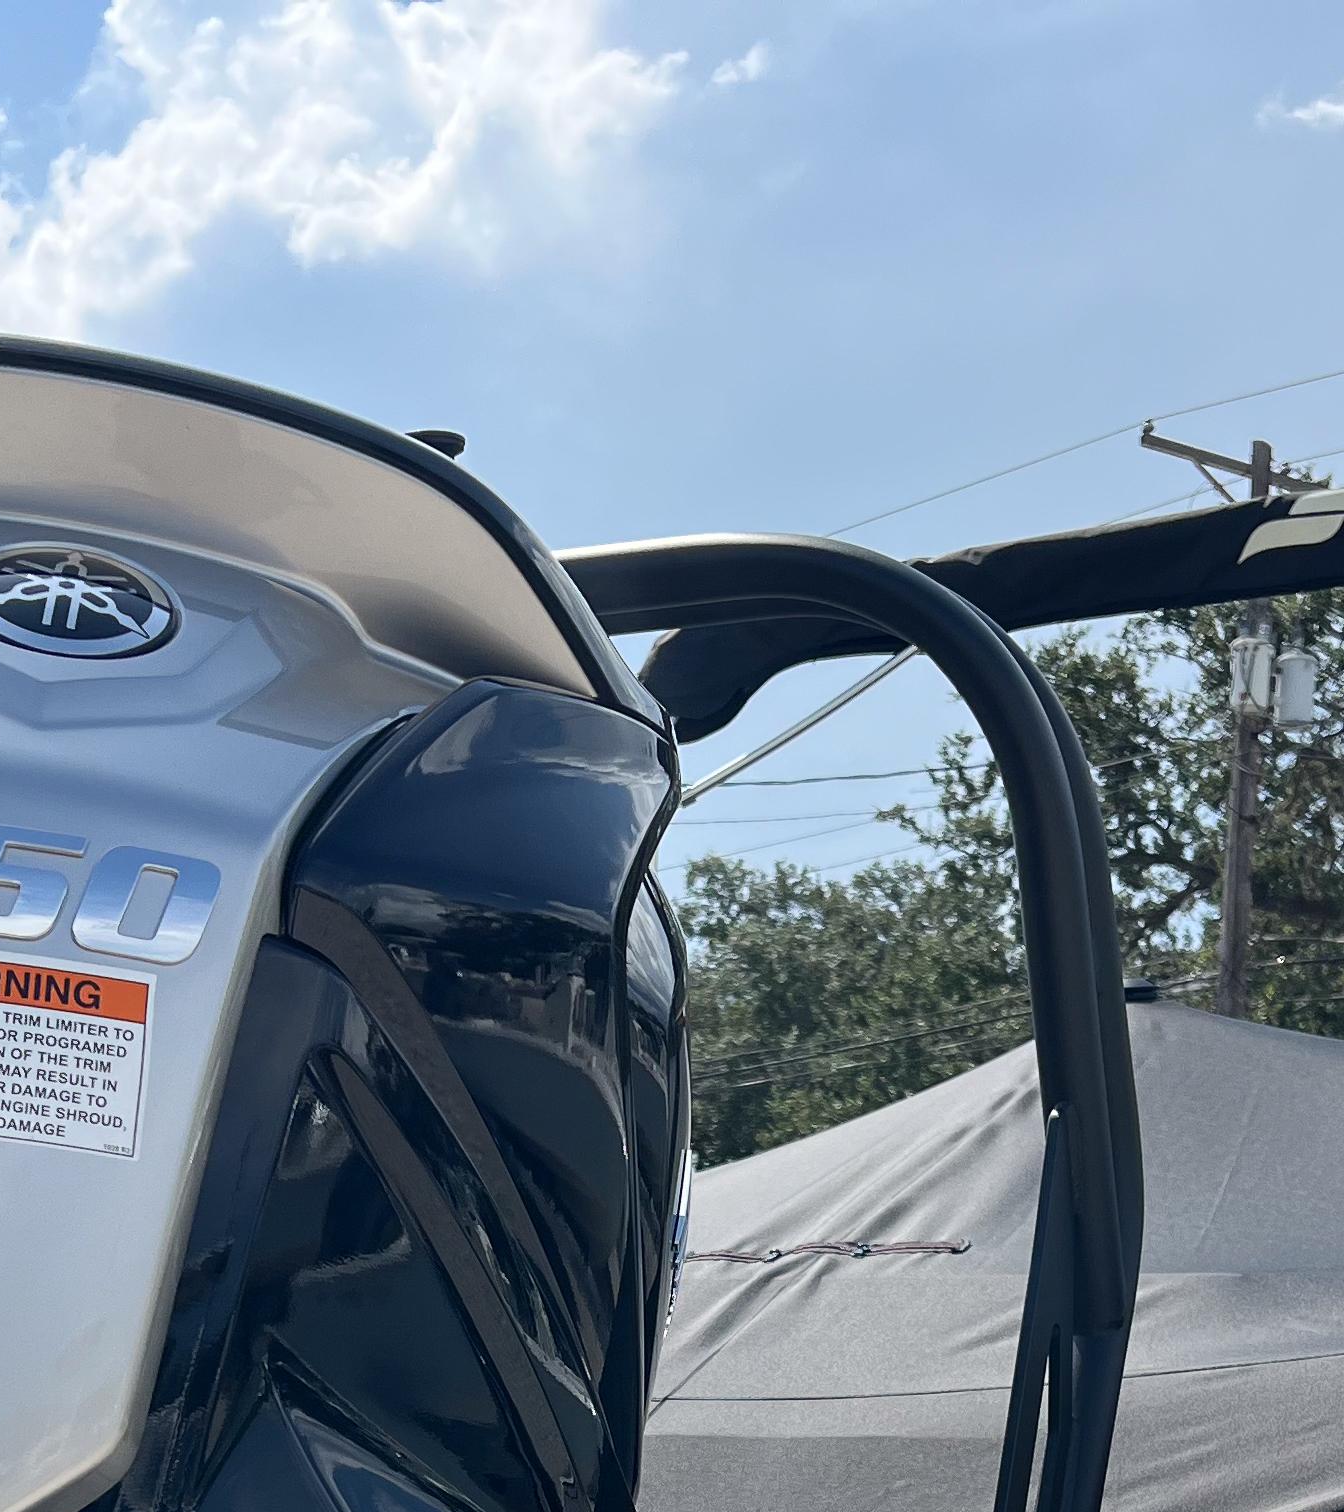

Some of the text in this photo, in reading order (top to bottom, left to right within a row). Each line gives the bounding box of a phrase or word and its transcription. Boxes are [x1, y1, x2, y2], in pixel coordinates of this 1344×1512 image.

[2, 1011, 41, 1028] TRIM
[46, 1017, 109, 1037] LIMITER
[113, 1027, 135, 1042] TO
[23, 1031, 128, 1058] PROGRAMED
[10, 1048, 33, 1061] OF
[37, 1051, 69, 1067] THE
[73, 1056, 112, 1073] TRIM
[36, 1069, 98, 1089] RESULT
[102, 1079, 118, 1093] IN
[11, 1083, 82, 1105] DAMAGE
[86, 1093, 108, 1108] TO
[55, 1107, 127, 1132] SHROUD,
